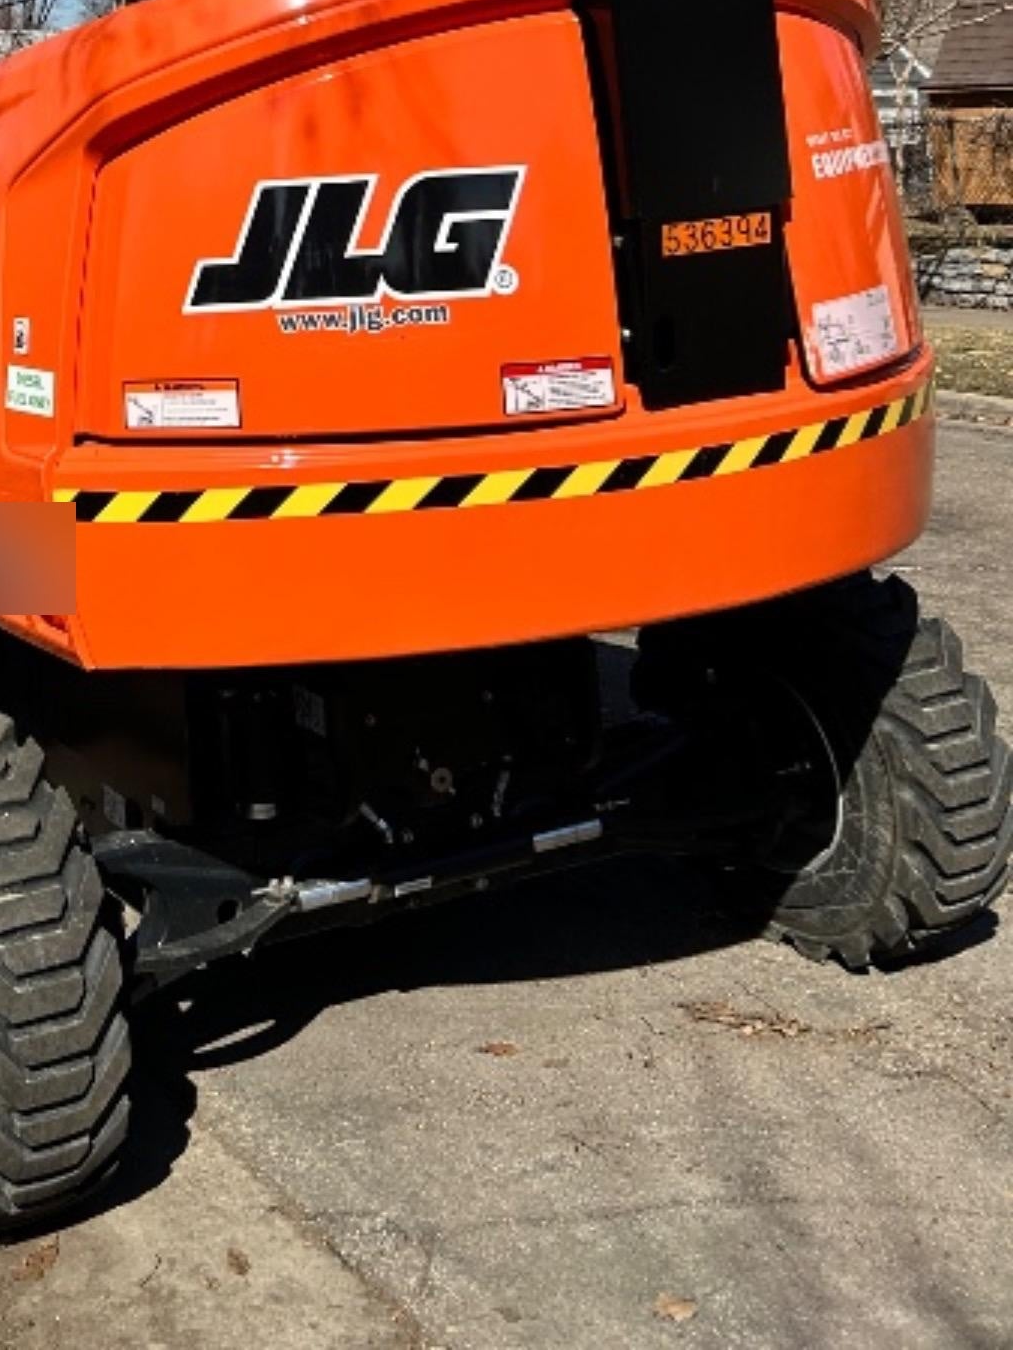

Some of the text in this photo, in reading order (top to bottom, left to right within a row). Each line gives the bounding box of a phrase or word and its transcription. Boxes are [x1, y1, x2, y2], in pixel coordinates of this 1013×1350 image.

[185, 166, 526, 311] JLG
[666, 215, 768, 253] 536394
[279, 304, 448, 333] www.jlg.com
